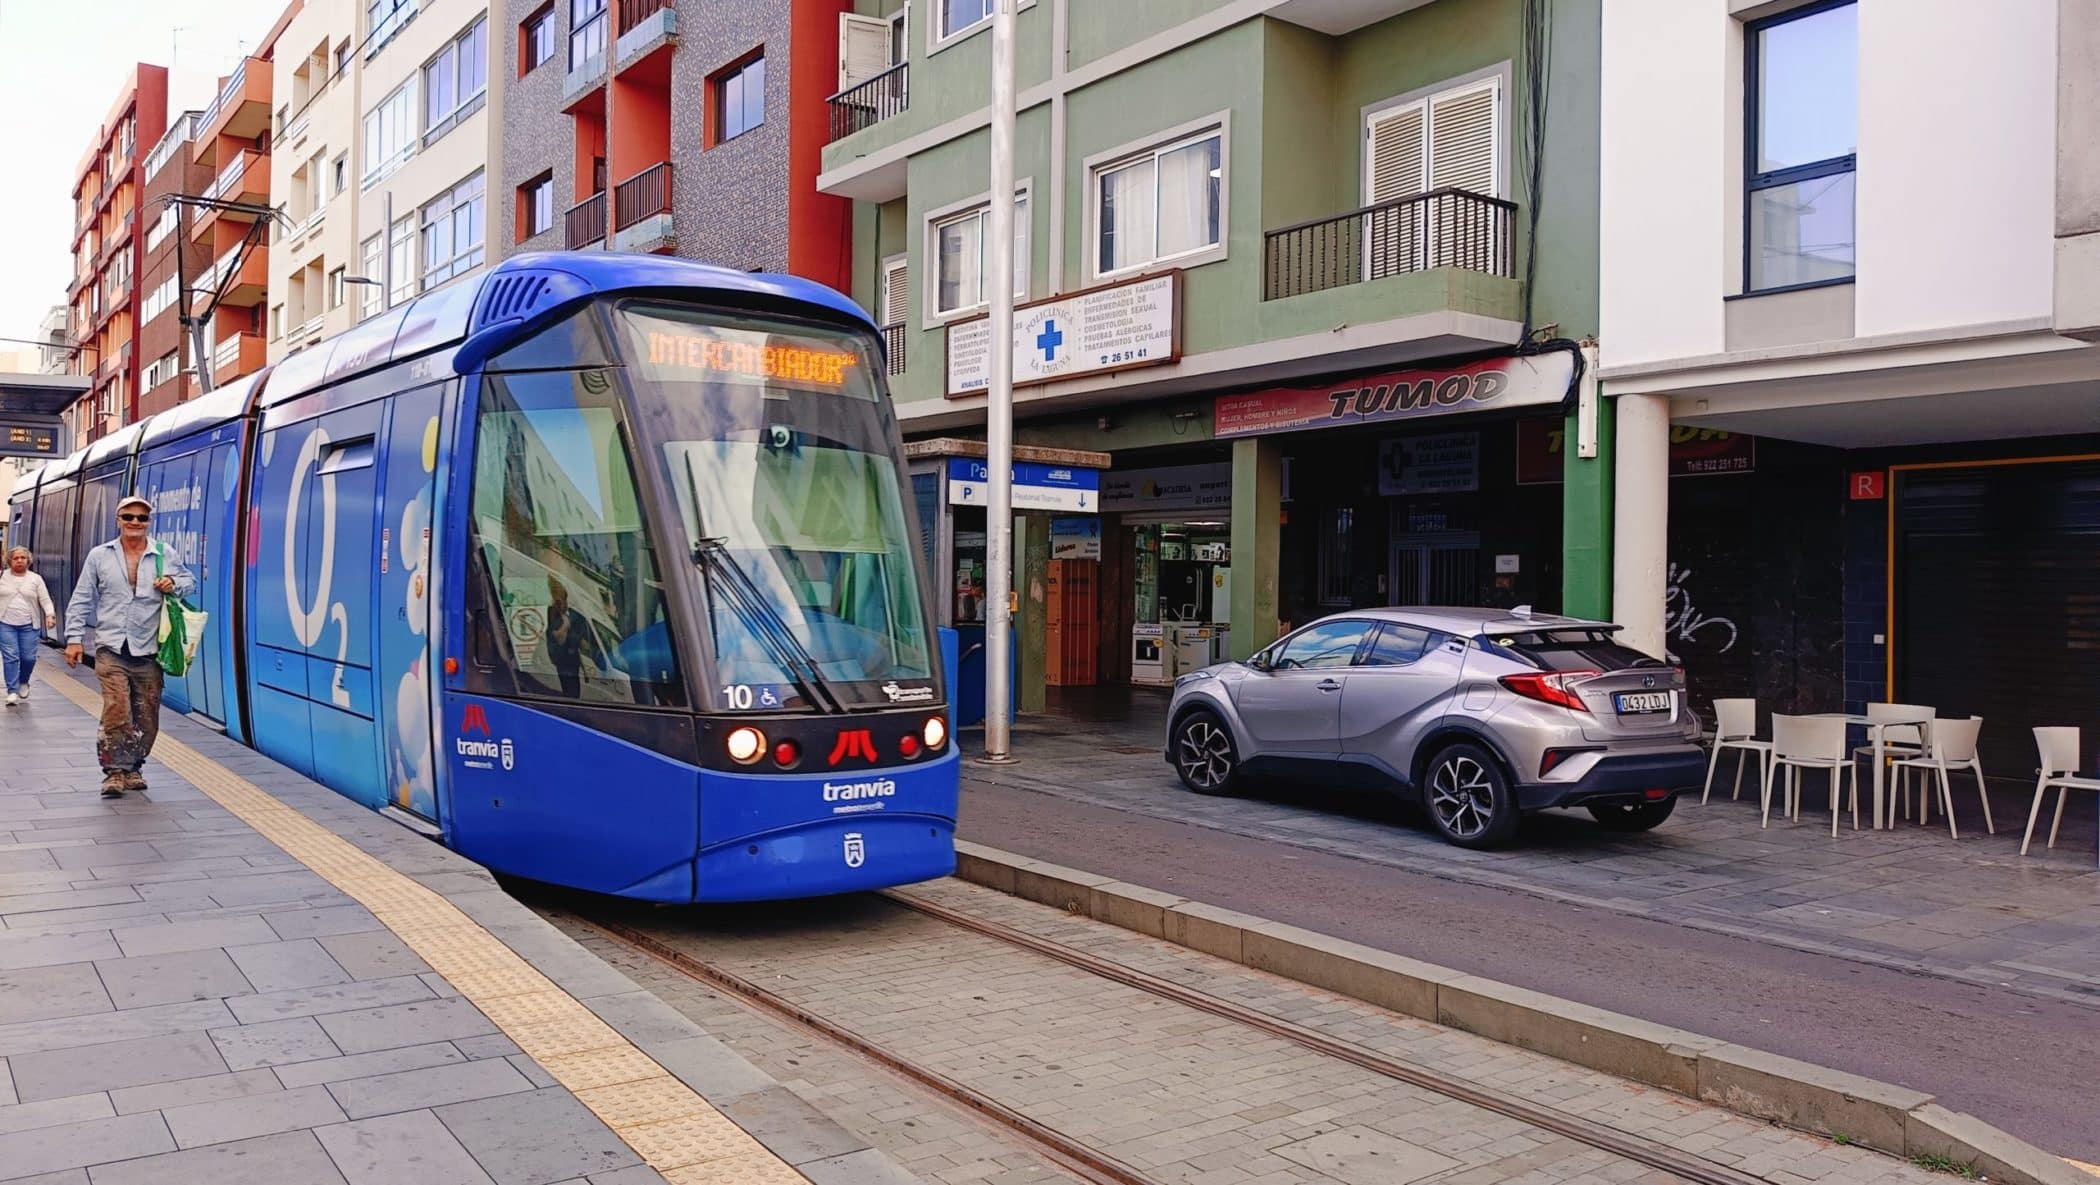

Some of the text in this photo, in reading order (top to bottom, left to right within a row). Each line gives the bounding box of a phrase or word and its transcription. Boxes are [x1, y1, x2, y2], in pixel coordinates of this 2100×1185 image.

[1135, 281, 1167, 294] FAMILIAR
[648, 331, 845, 384] INTERCAMBIADOR
[1112, 348, 1147, 363] 26 51 41
[1329, 370, 1509, 419] TUMOD
[1858, 475, 1874, 496] R
[722, 684, 753, 710] 10
